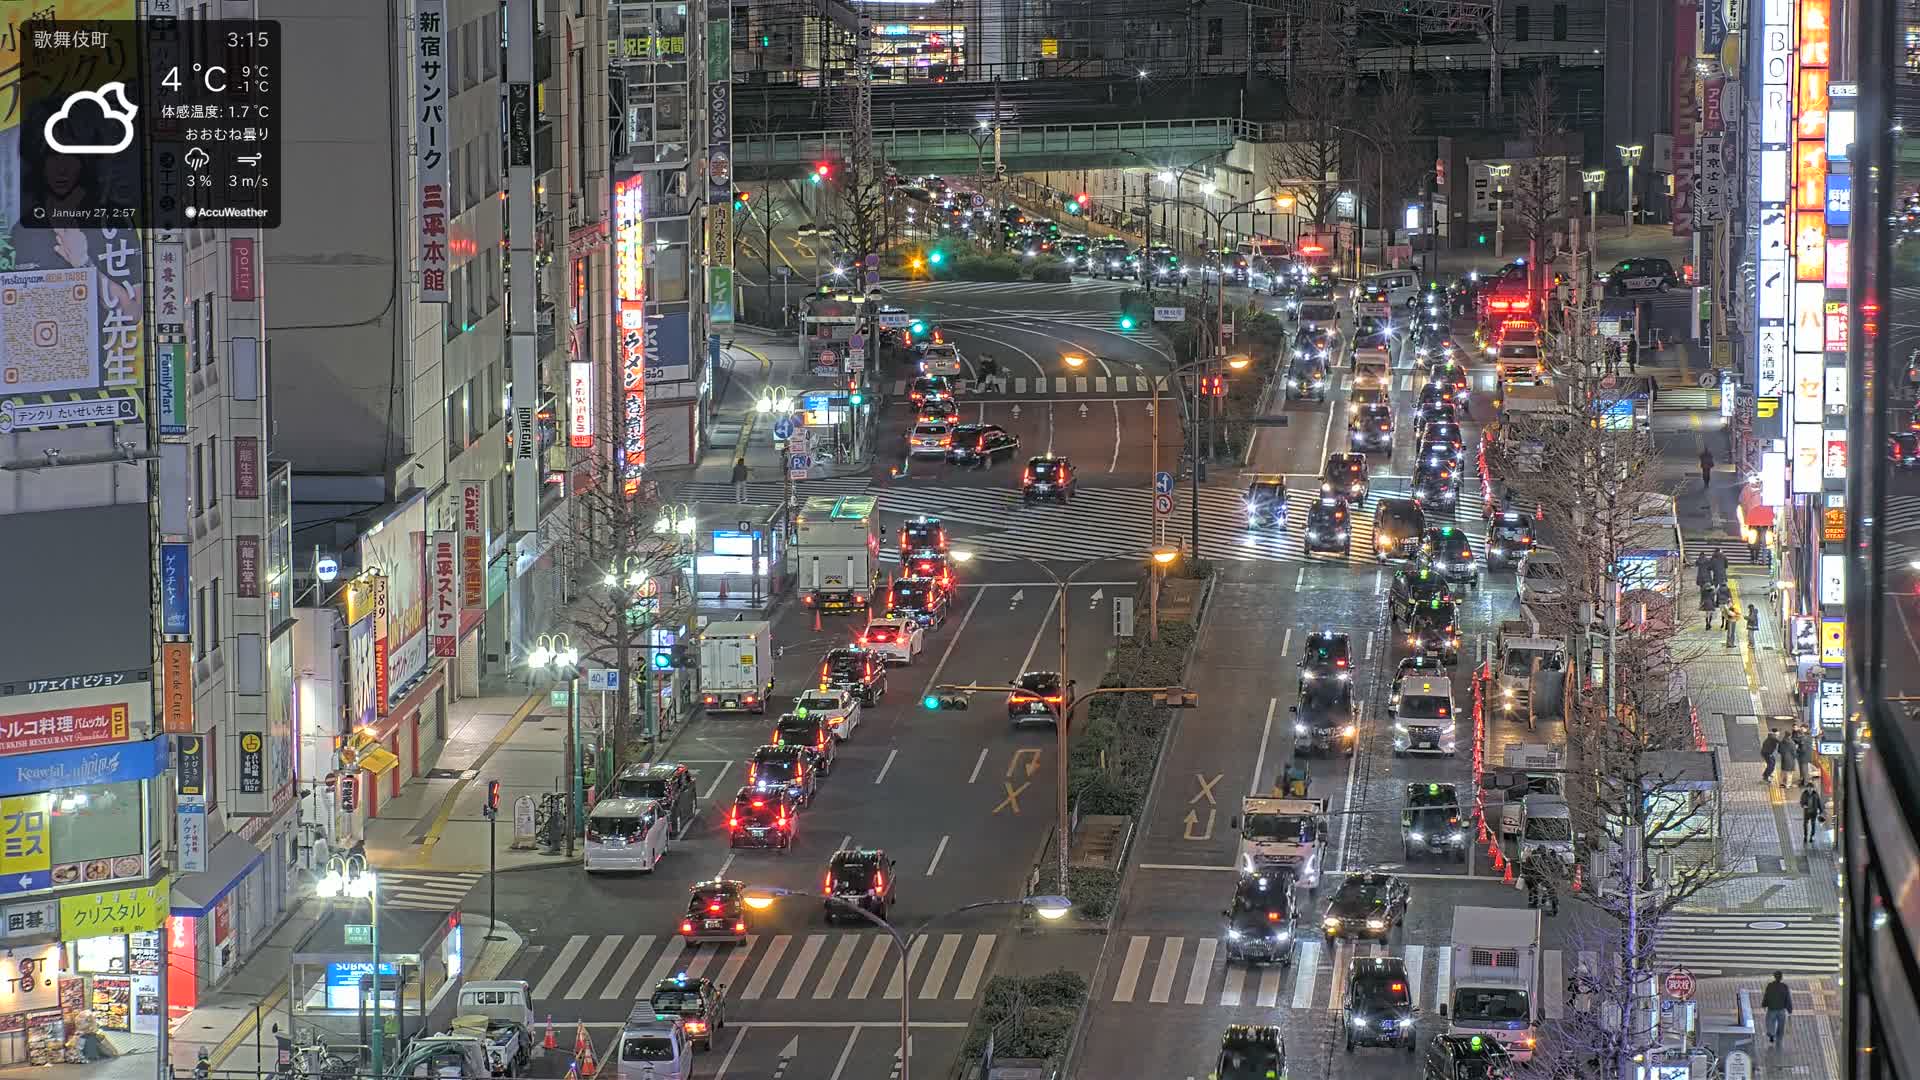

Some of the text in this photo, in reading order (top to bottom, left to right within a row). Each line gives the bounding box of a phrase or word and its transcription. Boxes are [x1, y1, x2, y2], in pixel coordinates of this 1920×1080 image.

[419, 11, 443, 171] 新宿サンパーク
[1708, 87, 1720, 121] アコム
[422, 183, 446, 292] 三平本館
[624, 331, 642, 388] ラーメン
[160, 353, 176, 414] FamilyMart
[58, 404, 116, 418] たいせい先生
[519, 407, 532, 460] HOMEGAME
[464, 486, 476, 531] GAME
[165, 555, 177, 605] ゲウチャイ
[241, 547, 255, 583] 龍生堂
[437, 542, 454, 629] 三平ストア
[29, 734, 74, 747] RESTAURANT
[4, 811, 43, 835] プロ
[4, 835, 43, 859] ミス
[8, 911, 44, 931] 囲碁
[73, 903, 146, 927] クリスタル
